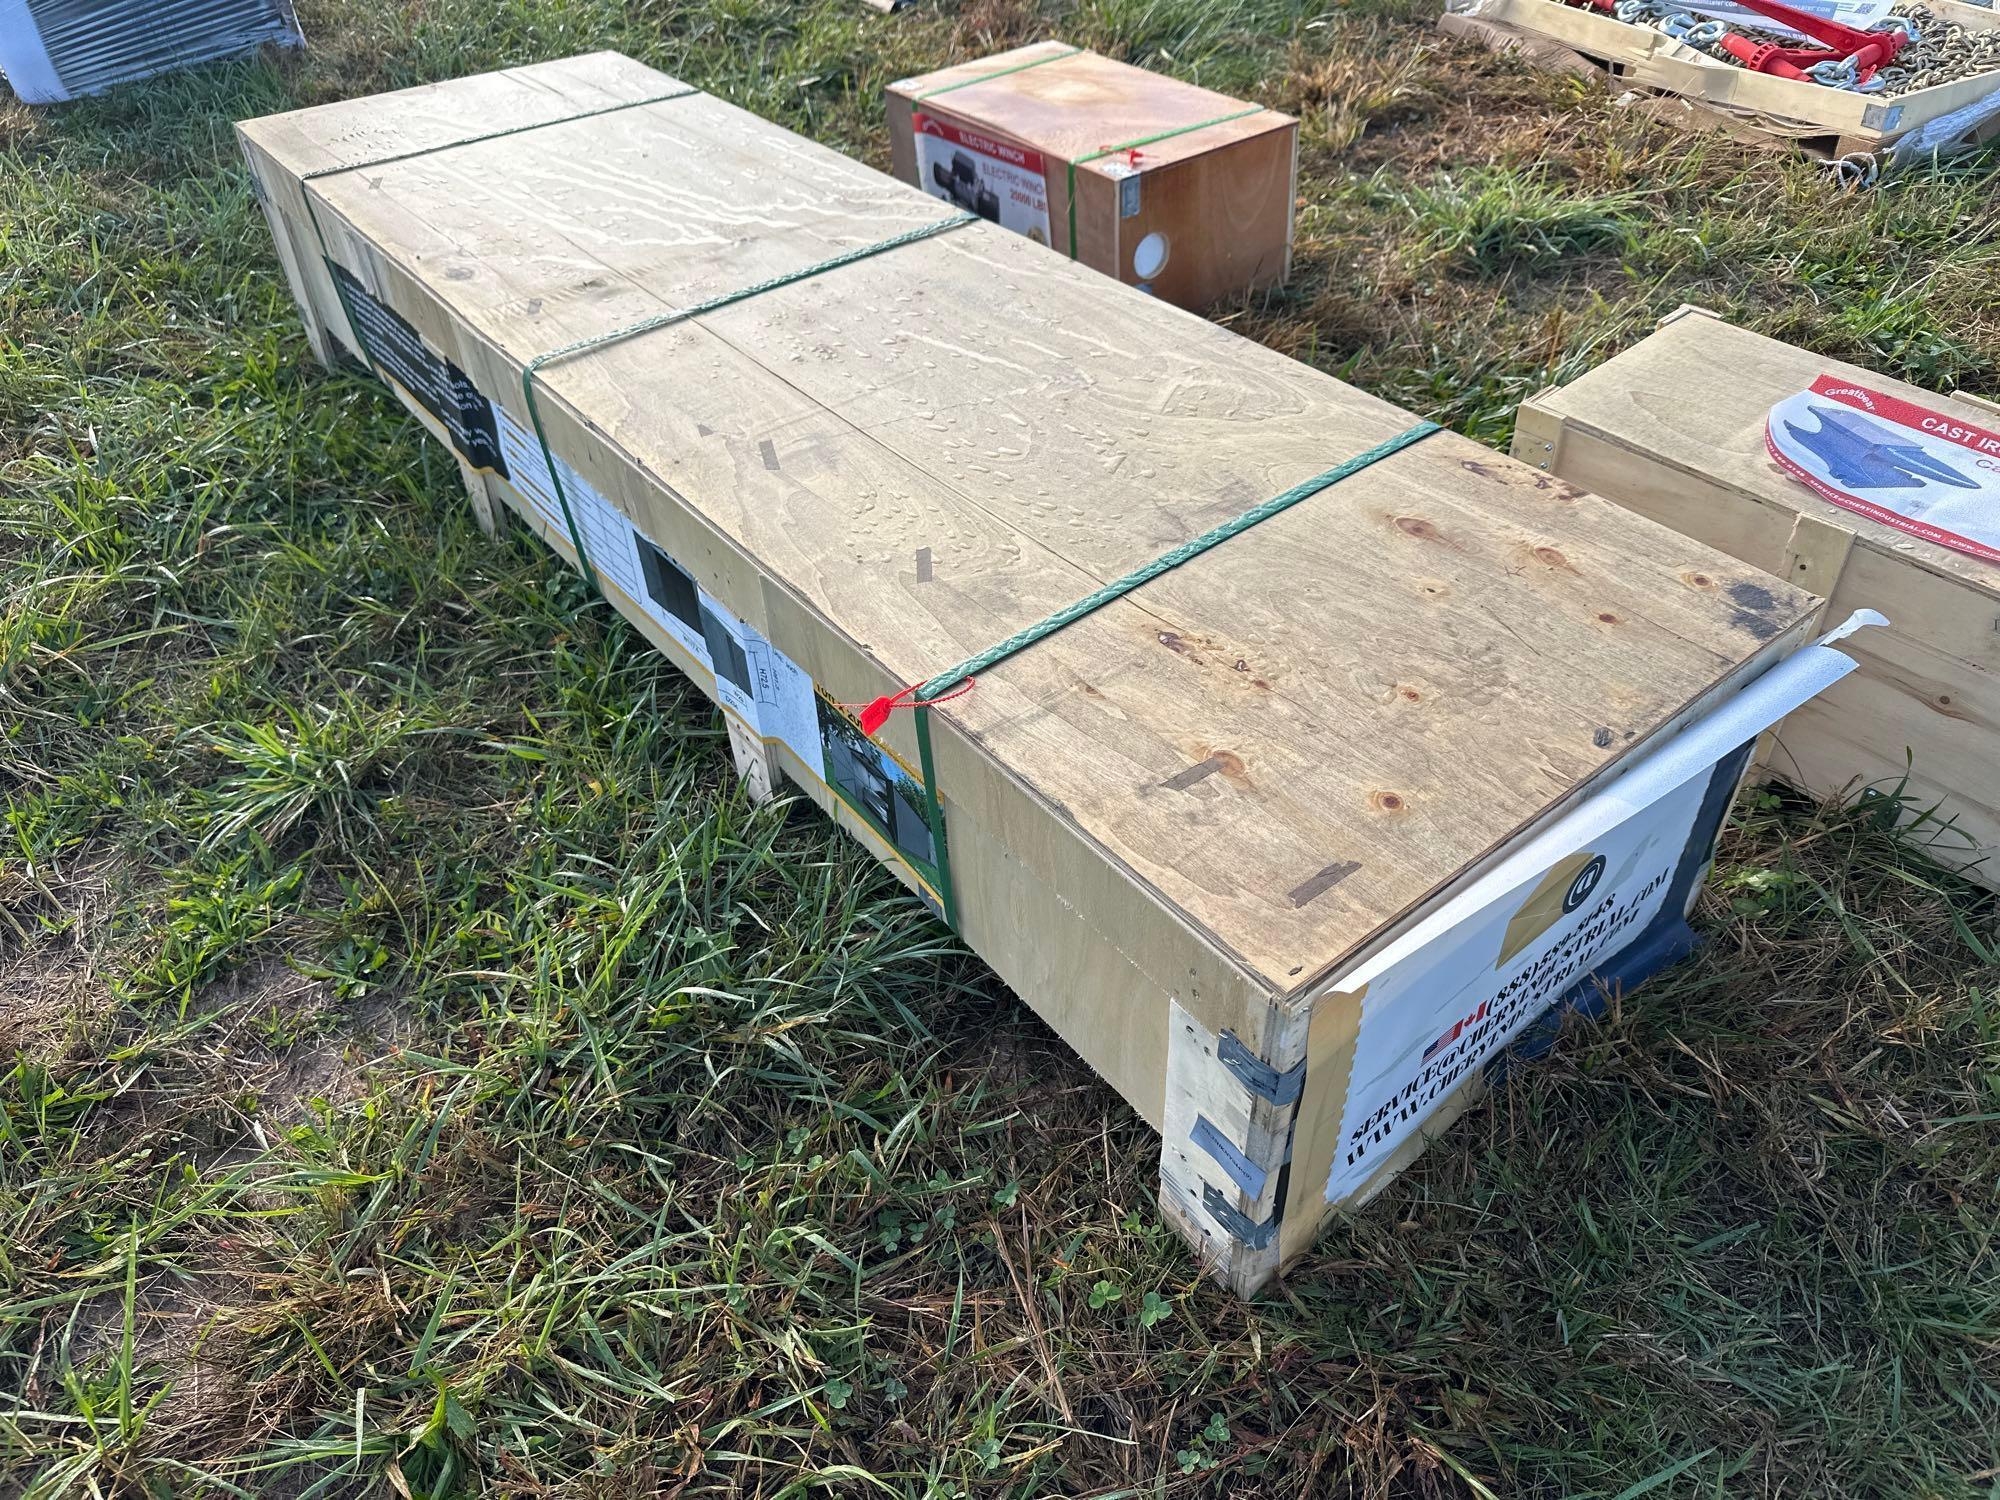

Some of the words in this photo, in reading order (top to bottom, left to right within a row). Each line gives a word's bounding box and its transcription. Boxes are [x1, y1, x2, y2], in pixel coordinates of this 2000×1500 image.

[958, 131, 997, 155] ELECTRIC
[997, 144, 1025, 165] WINCH
[982, 161, 1020, 187] ELECTRIC
[1824, 388, 1876, 411] Greatbear
[1921, 417, 1978, 443] CAST
[1977, 437, 2000, 454] IR
[1350, 866, 1670, 1146] SERVICE@CHERYINDUSTRIAL.COM
